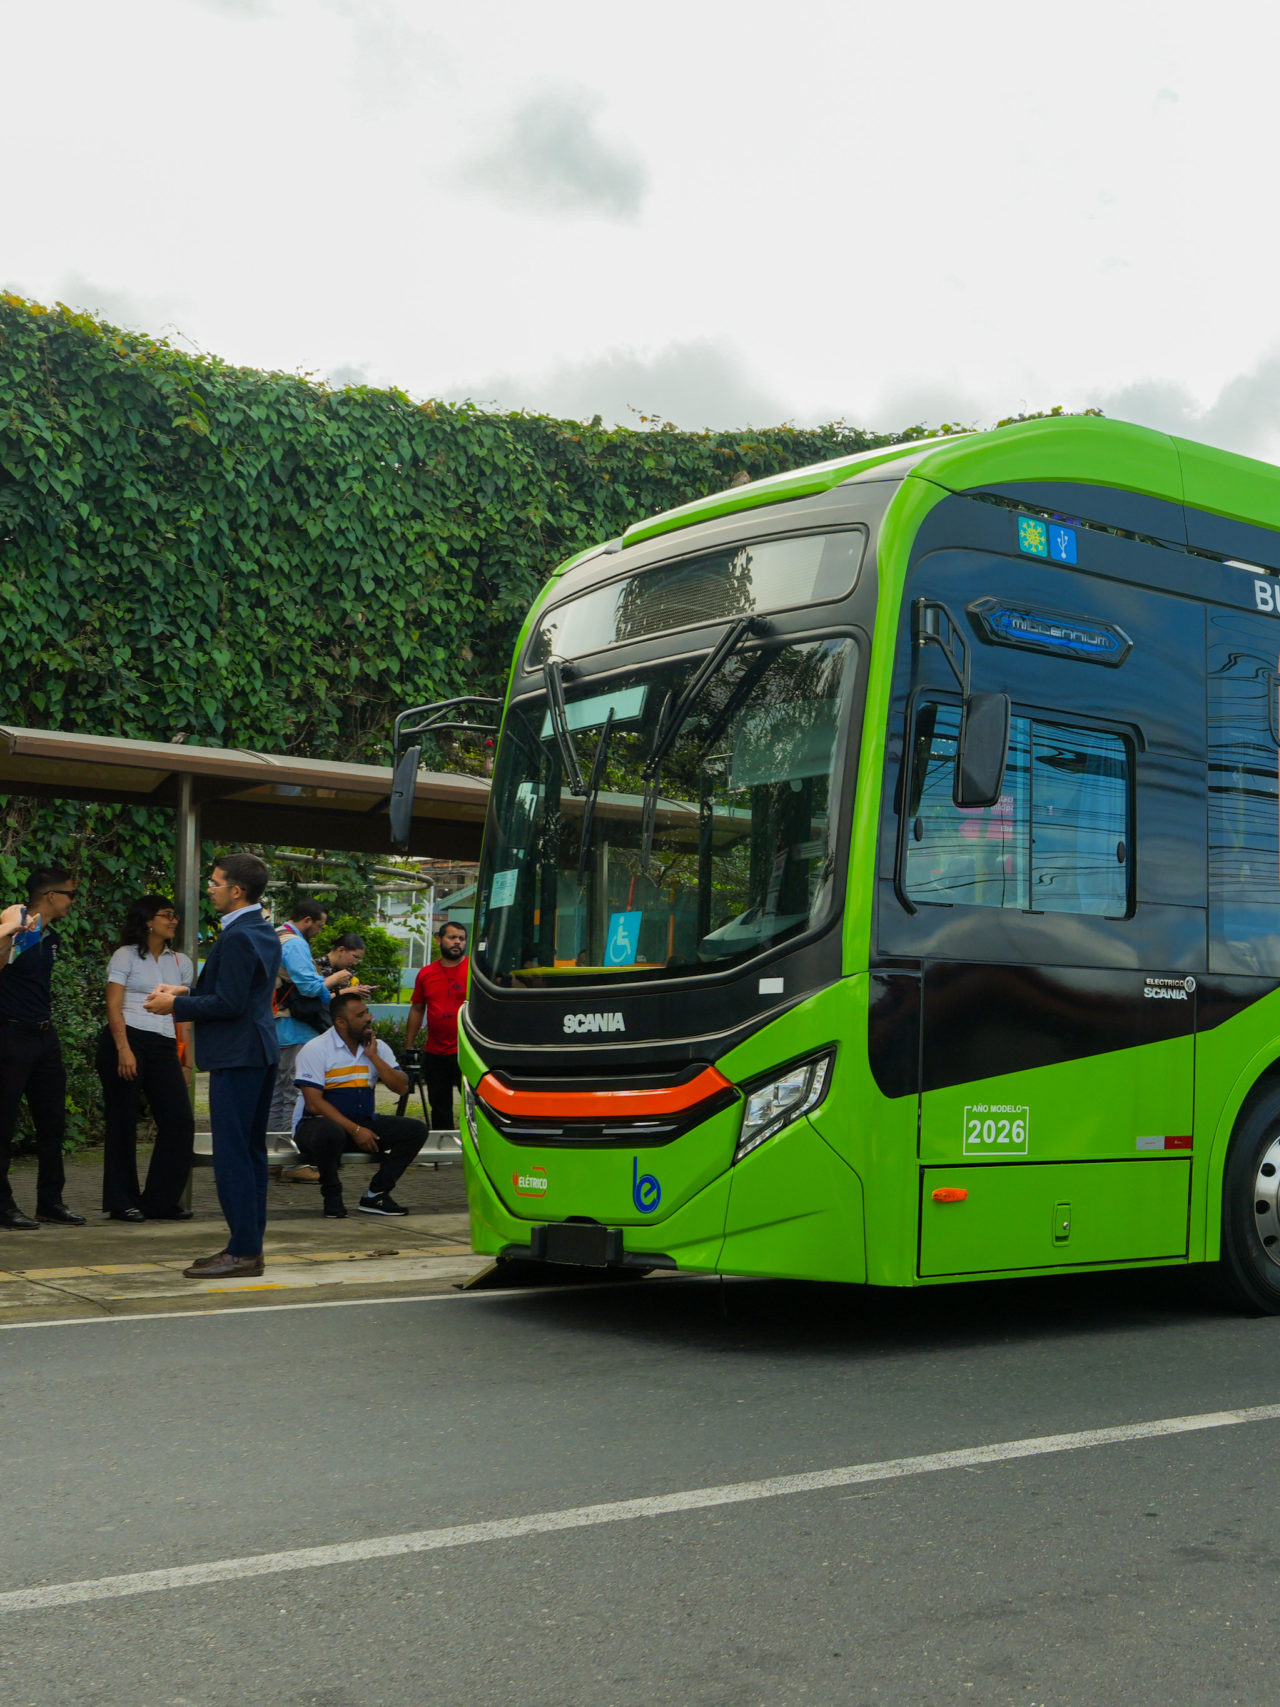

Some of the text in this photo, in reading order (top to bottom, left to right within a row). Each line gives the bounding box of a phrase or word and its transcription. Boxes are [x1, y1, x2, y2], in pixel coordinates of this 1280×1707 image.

[1146, 977, 1185, 987] ELECTRICO
[1143, 987, 1188, 1000] SCANIA
[563, 1012, 626, 1033] SCANIA
[972, 1103, 1023, 1113] AÑO MODELO
[967, 1119, 1025, 1144] 2026
[518, 1174, 548, 1190] ELÉTRICO
